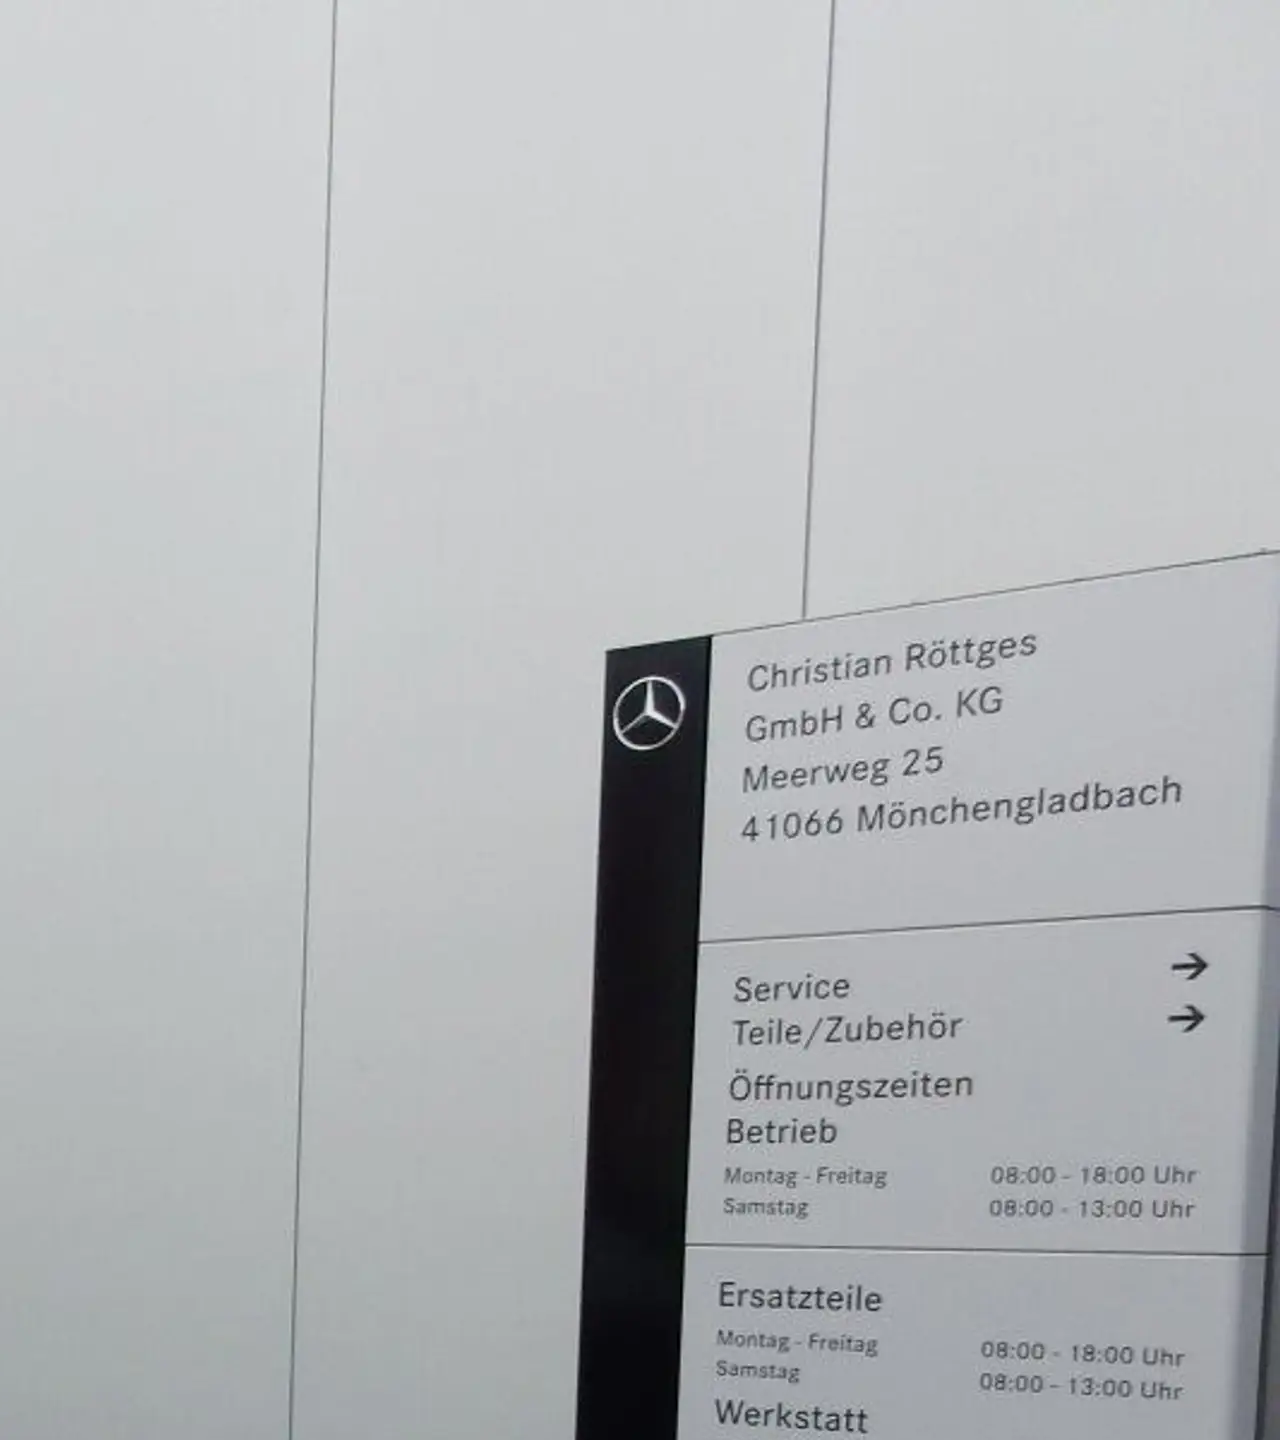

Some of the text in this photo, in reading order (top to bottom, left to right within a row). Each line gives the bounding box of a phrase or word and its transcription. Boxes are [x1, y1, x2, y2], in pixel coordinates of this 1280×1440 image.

[747, 633, 1038, 693] Christian Röttges
[745, 685, 1004, 743] GmbH & Co. KG
[742, 745, 944, 794] Meerweg 25
[740, 774, 1183, 843] 41066 Mönchengladbach
[733, 972, 851, 1004] Service
[732, 1011, 964, 1050] Teile/Zubehör
[728, 1068, 974, 1108] Öffnungszeiten
[726, 1117, 838, 1145] Betrieb
[723, 1166, 799, 1190] Montag
[816, 1165, 888, 1190] Freitag
[990, 1165, 1057, 1185] 08:00
[1081, 1165, 1146, 1185] 18:00
[1153, 1164, 1198, 1185] Uhr
[723, 1196, 810, 1220] Samstag
[988, 1198, 1055, 1218] 08:00
[1079, 1199, 1144, 1219] 13:00
[1151, 1199, 1196, 1219] Uhr
[718, 1280, 883, 1313] Ersatzteile
[716, 1328, 791, 1354] Montag
[807, 1332, 879, 1359] Freitag
[980, 1340, 1046, 1361] 08:00
[1071, 1343, 1136, 1365] 18:00
[1141, 1346, 1186, 1368] Uhr
[715, 1359, 801, 1385] Samstag
[978, 1372, 1045, 1394] 08:00
[1069, 1376, 1134, 1399] 13:00
[1140, 1380, 1184, 1401] Uhr
[714, 1398, 869, 1435] Werkstatt
